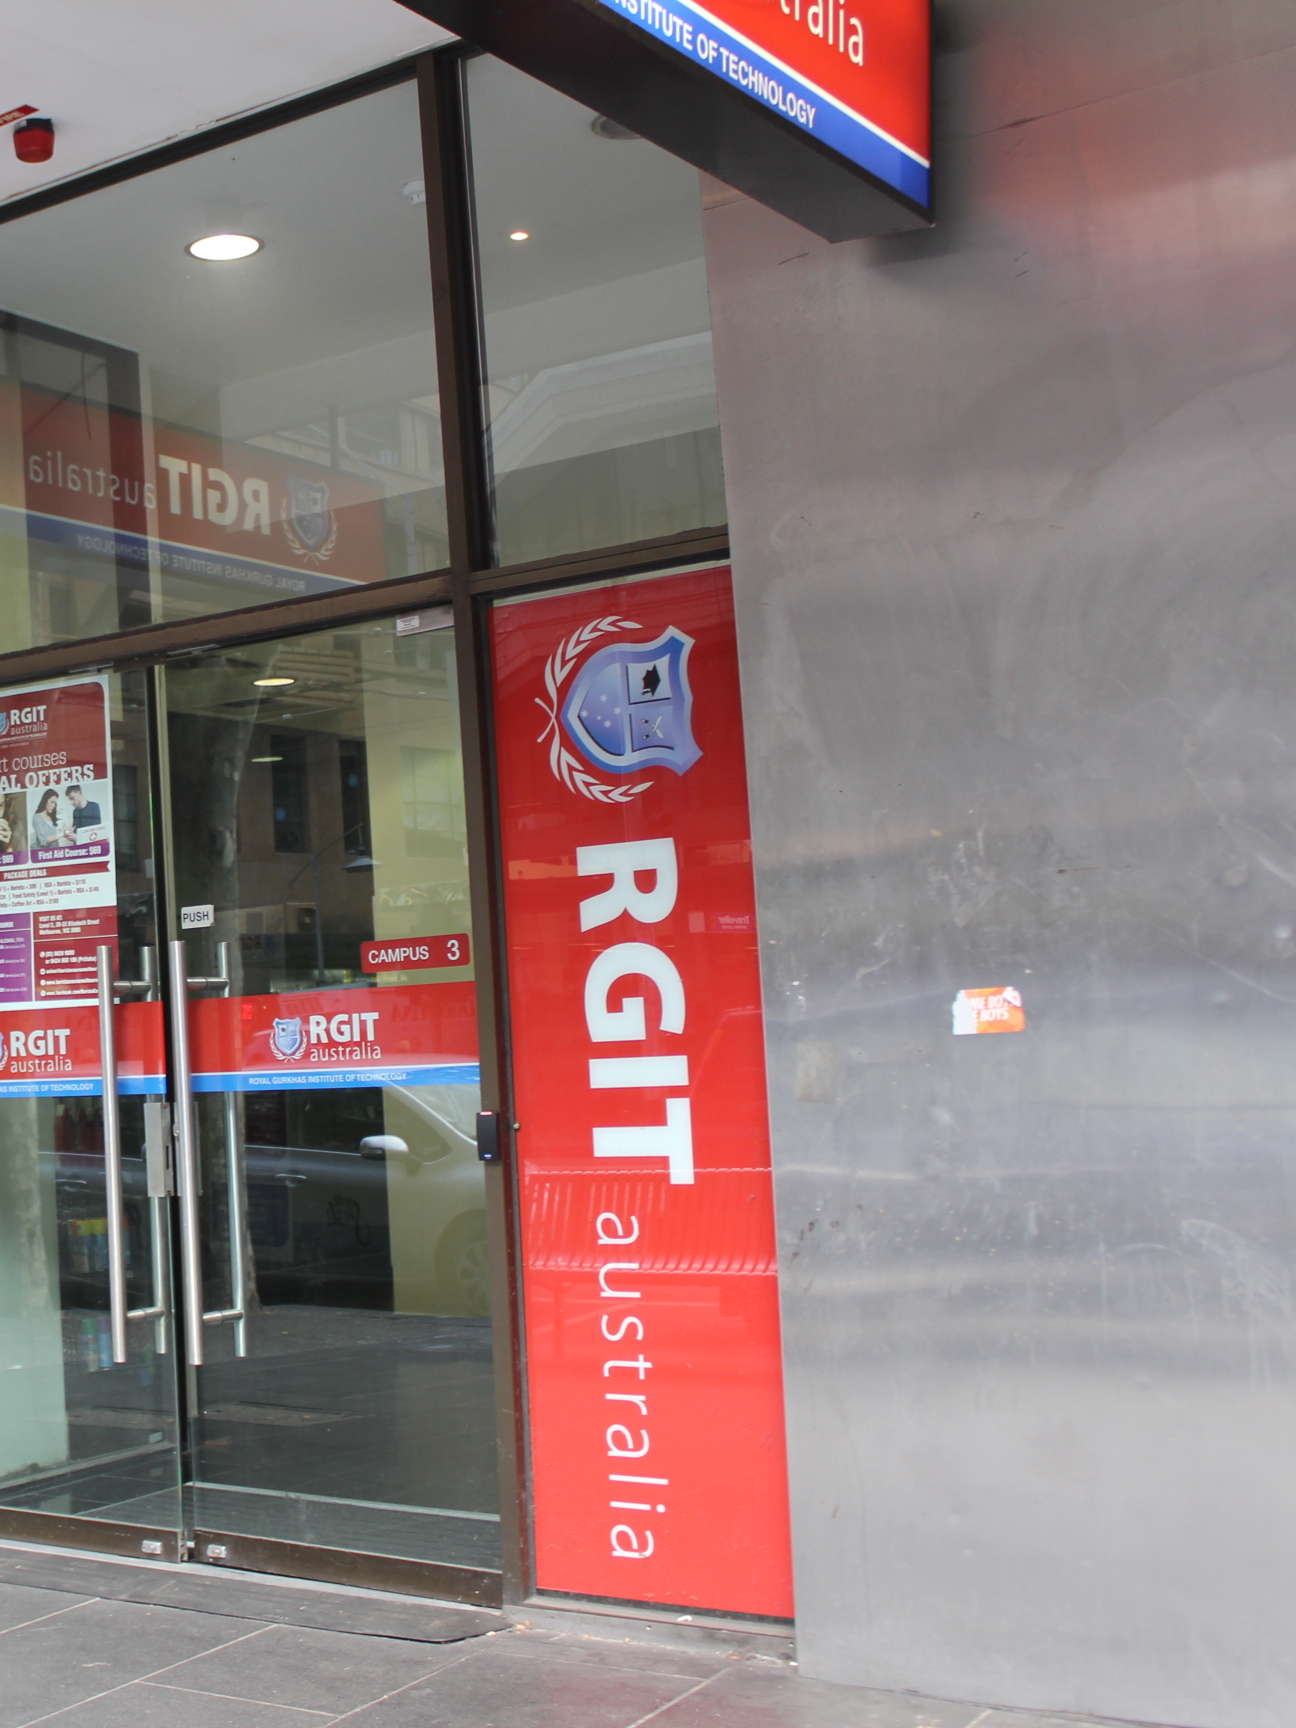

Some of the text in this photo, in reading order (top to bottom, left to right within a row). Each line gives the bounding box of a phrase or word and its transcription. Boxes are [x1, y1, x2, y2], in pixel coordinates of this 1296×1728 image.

[696, 33, 720, 64] OF
[719, 47, 816, 129] TECHNOLOGY
[10, 705, 47, 725] RGIT
[10, 721, 48, 735] australia
[12, 751, 67, 770] courses
[24, 764, 95, 789] OFFERS
[38, 850, 53, 860] First
[53, 849, 64, 859] Aid
[182, 910, 210, 924] PUSH
[368, 939, 460, 964] CAMPUS 3
[576, 837, 695, 1185] RGIT
[309, 1012, 379, 1044] RGIT
[10, 1028, 71, 1057] RGIT
[310, 1042, 382, 1062] australia
[10, 1055, 73, 1073] australia
[8, 1084, 39, 1093] INSTITUTE
[41, 1084, 50, 1092] OF
[50, 1083, 95, 1092] TECHNOLOGY
[249, 1072, 407, 1085] ROYAL GURKHAS INSTITUTE OF TECHNOLOGY
[596, 1212, 669, 1560] australia
